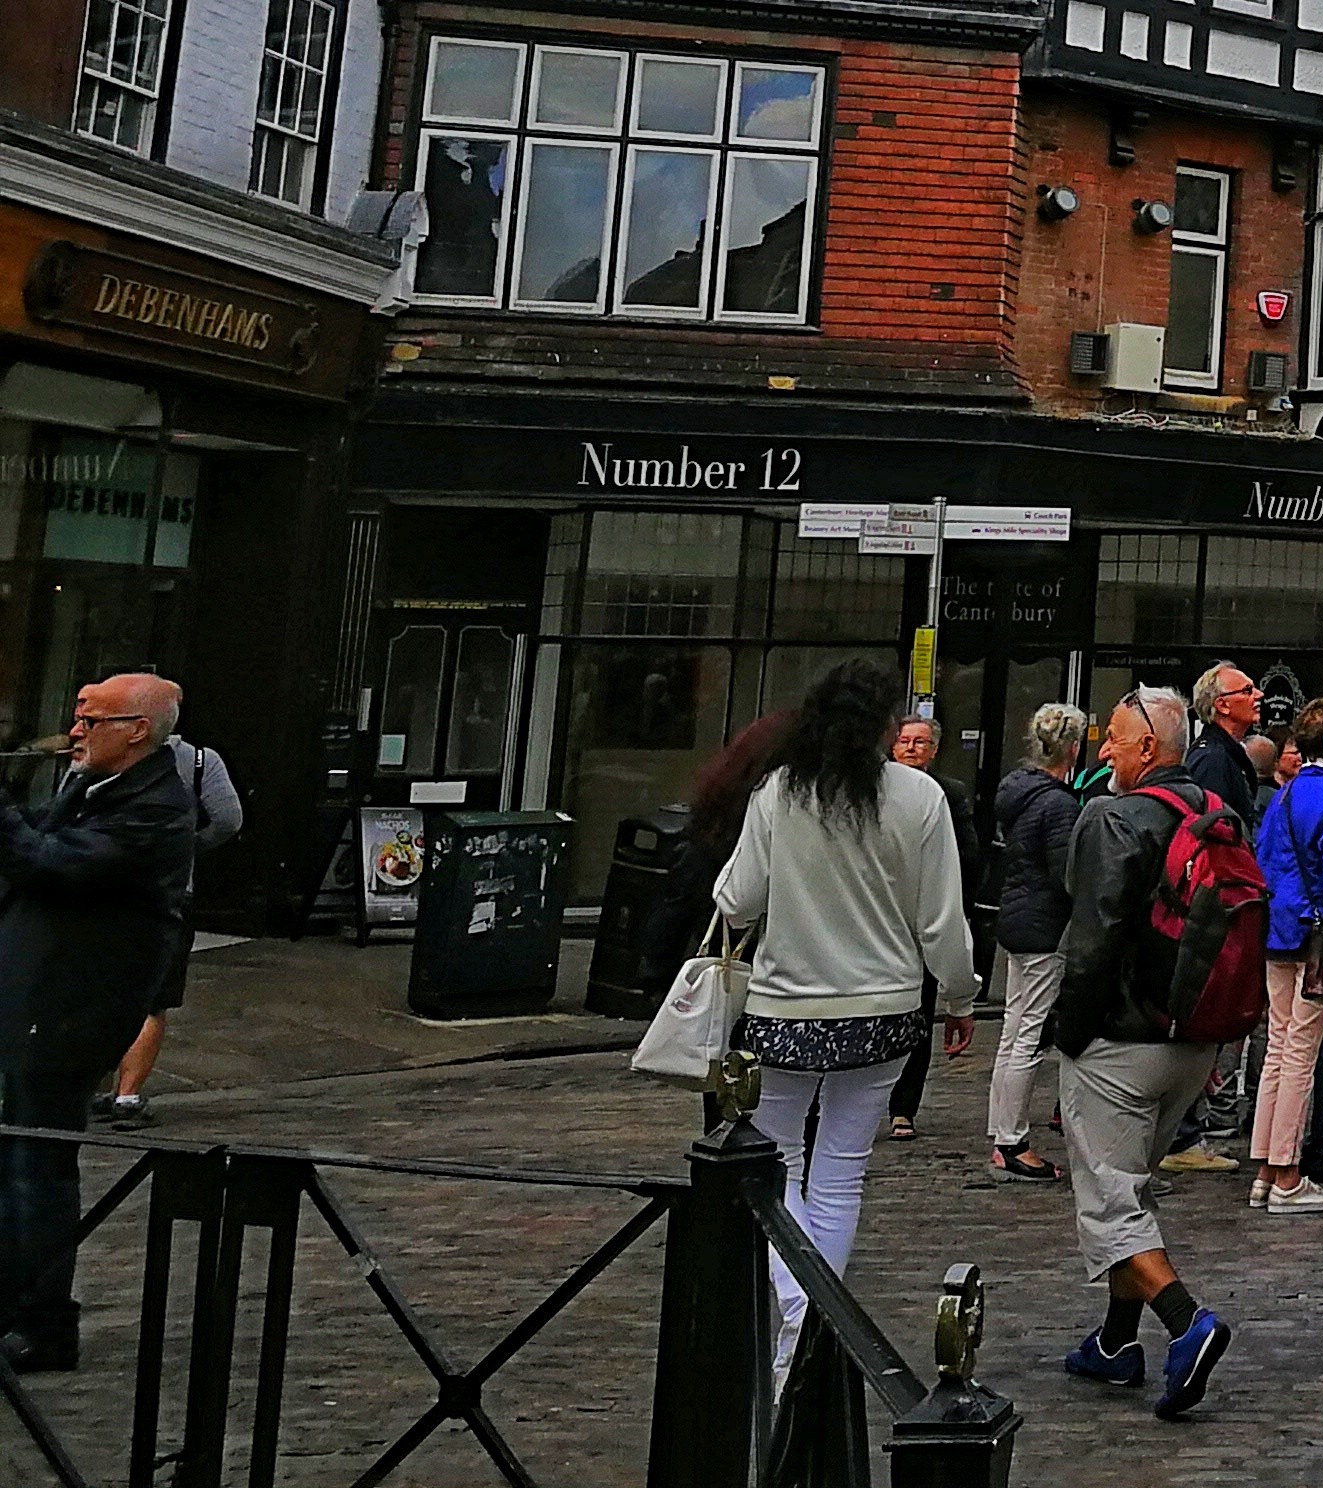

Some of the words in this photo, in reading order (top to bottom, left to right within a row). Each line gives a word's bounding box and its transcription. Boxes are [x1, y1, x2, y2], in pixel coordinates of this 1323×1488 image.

[94, 273, 273, 350] DEBENHAMS
[577, 442, 745, 489] Number
[759, 448, 801, 490] 12
[50, 482, 194, 524] DEBENHMS
[941, 576, 977, 596] The
[1041, 577, 1064, 597] of
